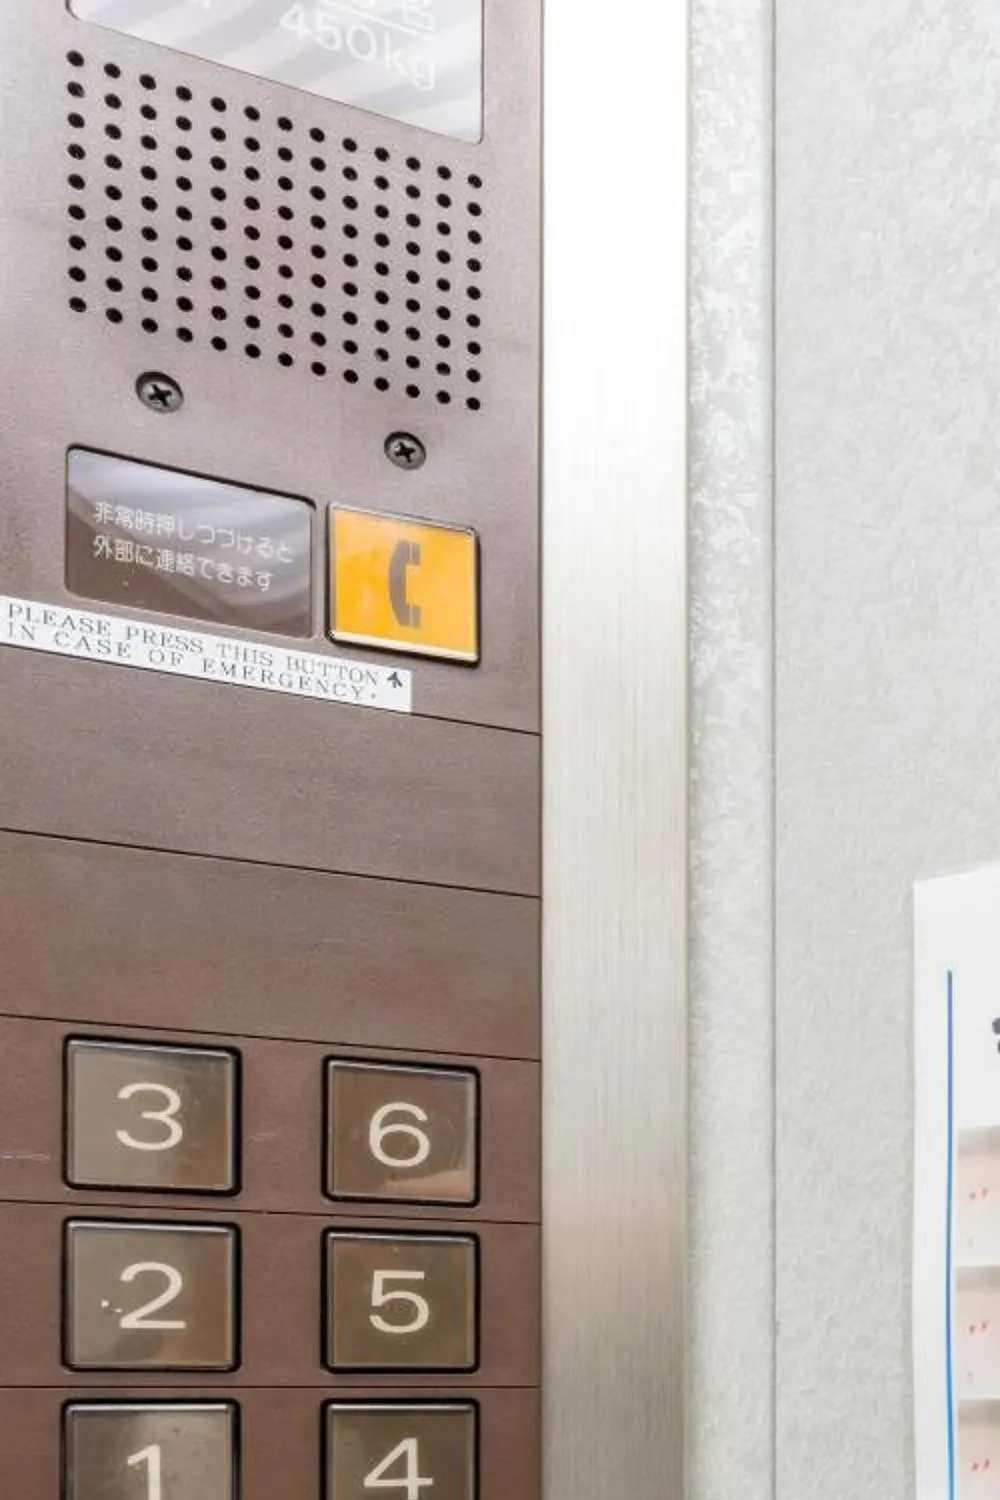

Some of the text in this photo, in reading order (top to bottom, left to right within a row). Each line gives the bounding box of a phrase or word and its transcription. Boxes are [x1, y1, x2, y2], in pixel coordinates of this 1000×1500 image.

[279, 3, 436, 91] 450kg
[92, 534, 274, 592] 外部に連絡できます
[93, 500, 294, 563] 非常時押しつづけると
[8, 602, 379, 686] PLEASE PRESS THIS BUTTON
[8, 621, 377, 700] IN CASE OF EMERGENCY.
[115, 1082, 184, 1151] 3
[368, 1102, 431, 1168] 6
[116, 1261, 187, 1329] 2
[369, 1269, 430, 1334] 5
[363, 1437, 434, 1500] 4
